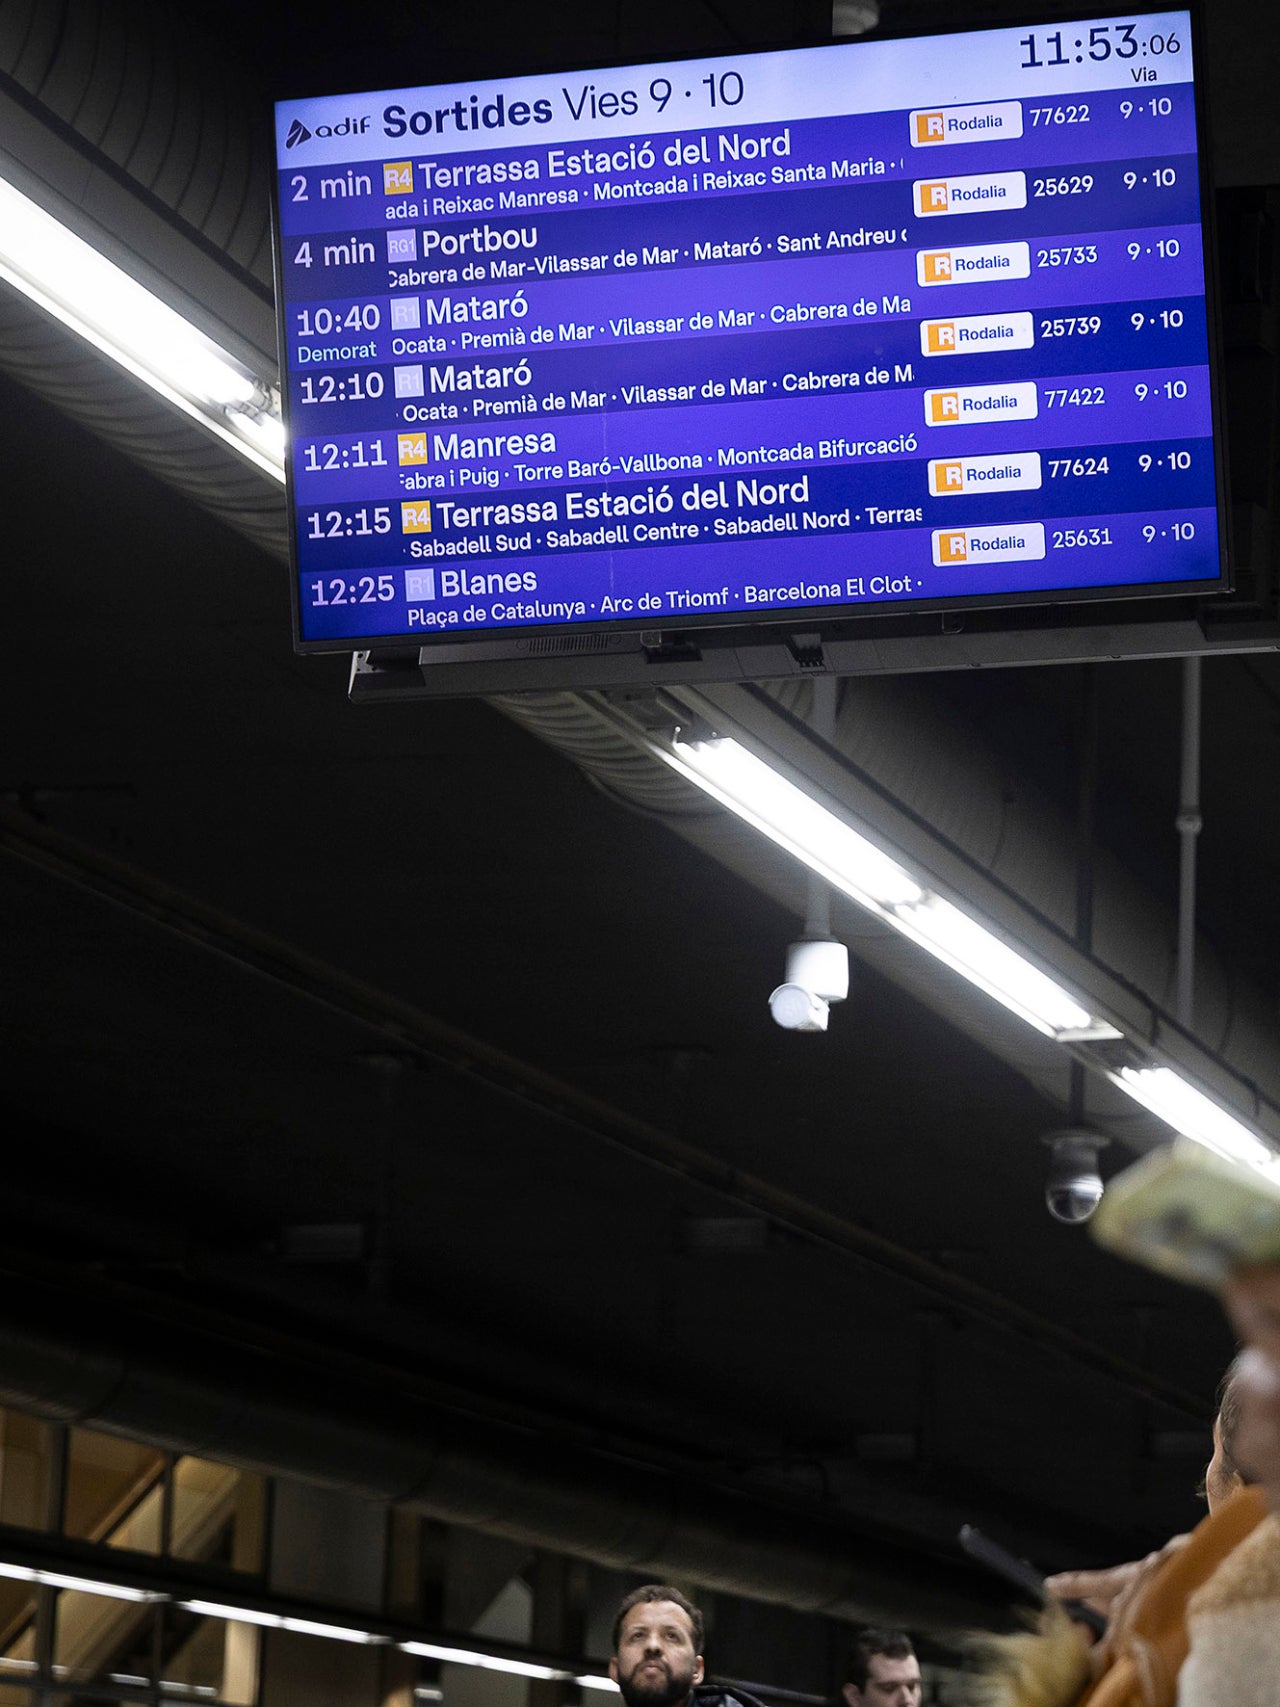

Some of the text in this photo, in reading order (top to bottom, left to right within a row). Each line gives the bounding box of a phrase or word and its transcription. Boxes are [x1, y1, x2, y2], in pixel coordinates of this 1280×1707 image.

[1131, 66, 1157, 82] Via
[315, 115, 370, 138] adif
[383, 94, 552, 138] Sortides
[562, 85, 638, 120] Vies
[927, 115, 1002, 136] R Rodalia
[1029, 104, 1089, 126] 77622
[384, 128, 790, 189] R4 Terrassa Estació del Nord
[291, 170, 371, 201] 2 min
[423, 198, 427, 216] i
[433, 195, 494, 215] Reixac
[499, 189, 578, 209] Manresa
[593, 175, 688, 200] Montcada
[693, 173, 697, 191] i
[703, 170, 766, 190] Reixac
[771, 164, 826, 183] Santa
[831, 157, 885, 178] Maria
[931, 185, 1006, 206] R Rodalia
[1033, 175, 1093, 196] 25629
[294, 237, 375, 267] 4 min
[389, 224, 537, 257] RG1 Portbou
[462, 262, 485, 280] de
[490, 255, 608, 278] Mar-Vilassar
[613, 249, 637, 267] de
[642, 246, 679, 264] Mar
[694, 236, 762, 260] Mataró
[777, 233, 821, 252] Sant
[826, 228, 895, 248] Andreu
[934, 256, 1009, 276] R Rodalia
[1037, 245, 1097, 267] 25733
[297, 304, 380, 336] 10:40
[426, 289, 528, 324] Mataró
[392, 295, 910, 354] Ocata Premià de Mar Vilassar de Mar Cabrera de Ma
[938, 326, 1013, 346] R Rodalia
[1041, 316, 1100, 337] 25739
[298, 341, 376, 363] Demorat
[301, 372, 383, 403] 12:10
[430, 358, 531, 393] Mataró
[403, 364, 914, 421] Ocata Premià de Mar Vilassar de Mar Cabrera de M
[942, 396, 1017, 416] R Rodalia
[1044, 387, 1104, 407] 77422
[304, 439, 387, 470] 12:11
[400, 432, 555, 460] R4 Manresa
[449, 469, 454, 486] i
[459, 466, 499, 487] Puig
[513, 464, 563, 481] Torre
[568, 453, 702, 477] Baró-Vallbona
[718, 442, 813, 466] Montcada
[818, 433, 917, 458] Bifurcació
[946, 466, 1021, 486] R Rodalia
[1048, 457, 1109, 477] 77624
[403, 475, 808, 528] R4 Terrassa Estació del Nord
[308, 507, 391, 538] 12:15
[410, 535, 491, 557] Sabadell
[496, 532, 531, 551] Sud
[546, 525, 629, 547] Sabadell
[633, 522, 699, 541] Centre
[714, 512, 798, 535] Sabadell
[802, 508, 850, 529] Nord
[1052, 527, 1112, 548] 25631
[950, 536, 1025, 556] R Rodalia
[311, 575, 394, 605] 12:25
[441, 569, 537, 596] Blanes
[408, 575, 911, 627] Plaça de Catalunya Arc de Triomf Barcelona El Clot
